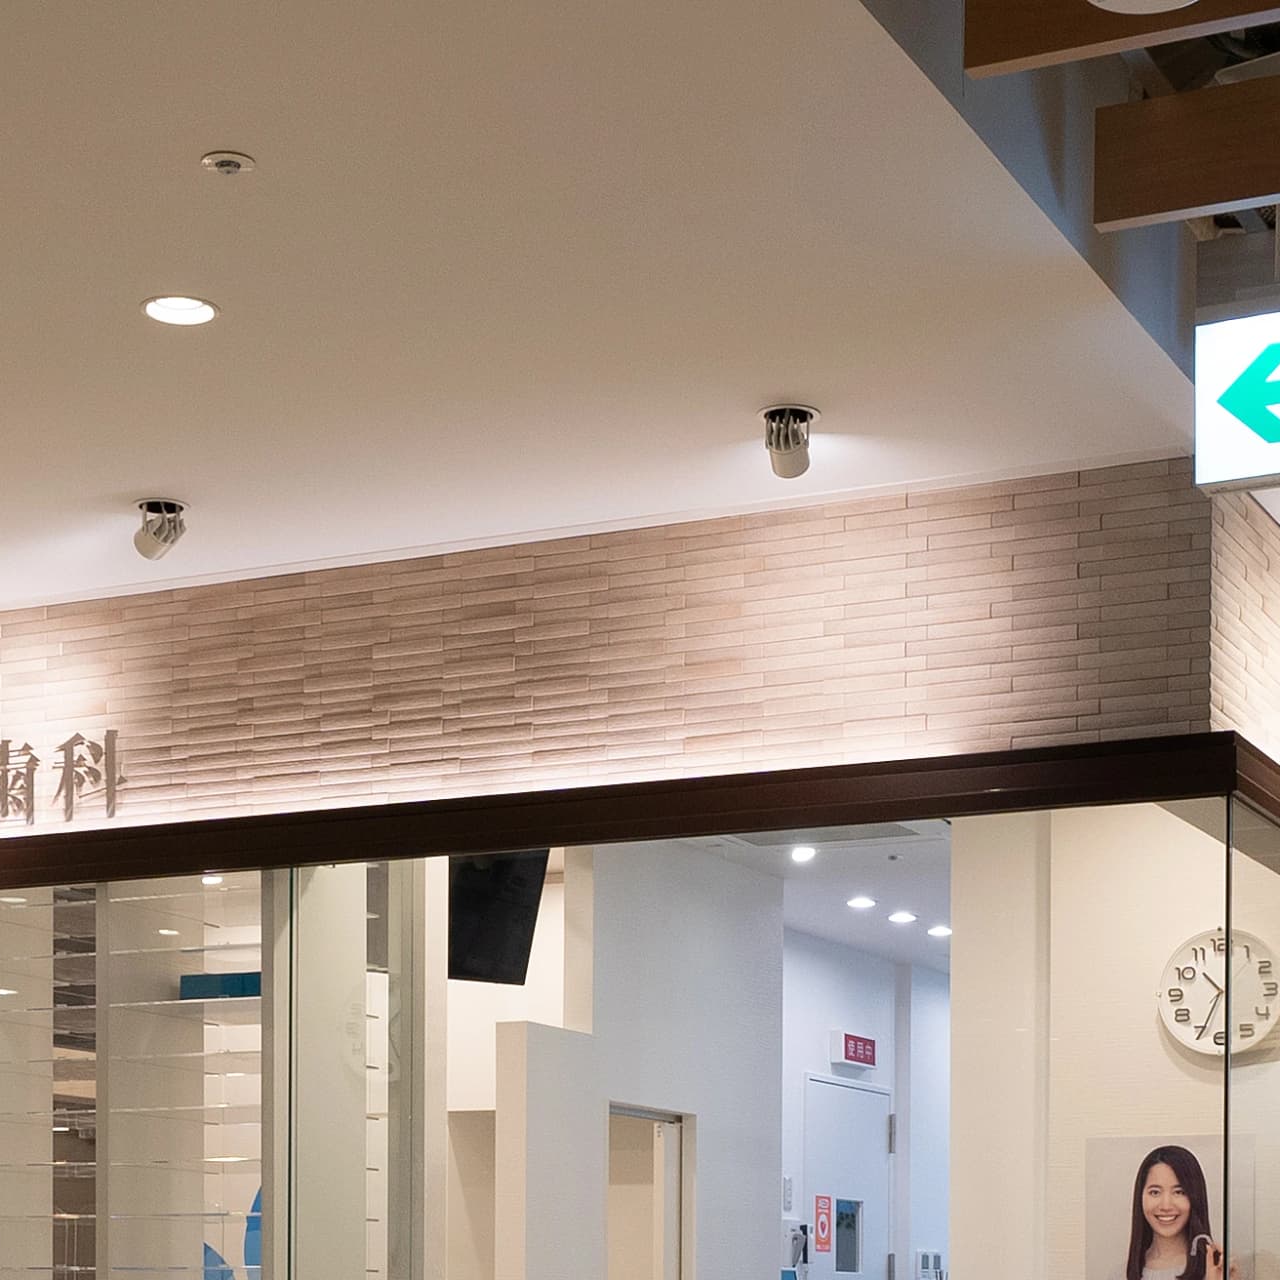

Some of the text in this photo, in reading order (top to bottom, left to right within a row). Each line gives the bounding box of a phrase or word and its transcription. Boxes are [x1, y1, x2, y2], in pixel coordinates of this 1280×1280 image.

[1192, 947, 1205, 961] 11
[1243, 945, 1250, 960] 1
[1175, 966, 1196, 981] 10
[1258, 960, 1272, 975] 2
[1168, 988, 1183, 1003] 9
[1263, 982, 1278, 997] 3
[1174, 1008, 1190, 1023] 8
[1255, 1006, 1270, 1021] 4
[1239, 1023, 1255, 1039] 5
